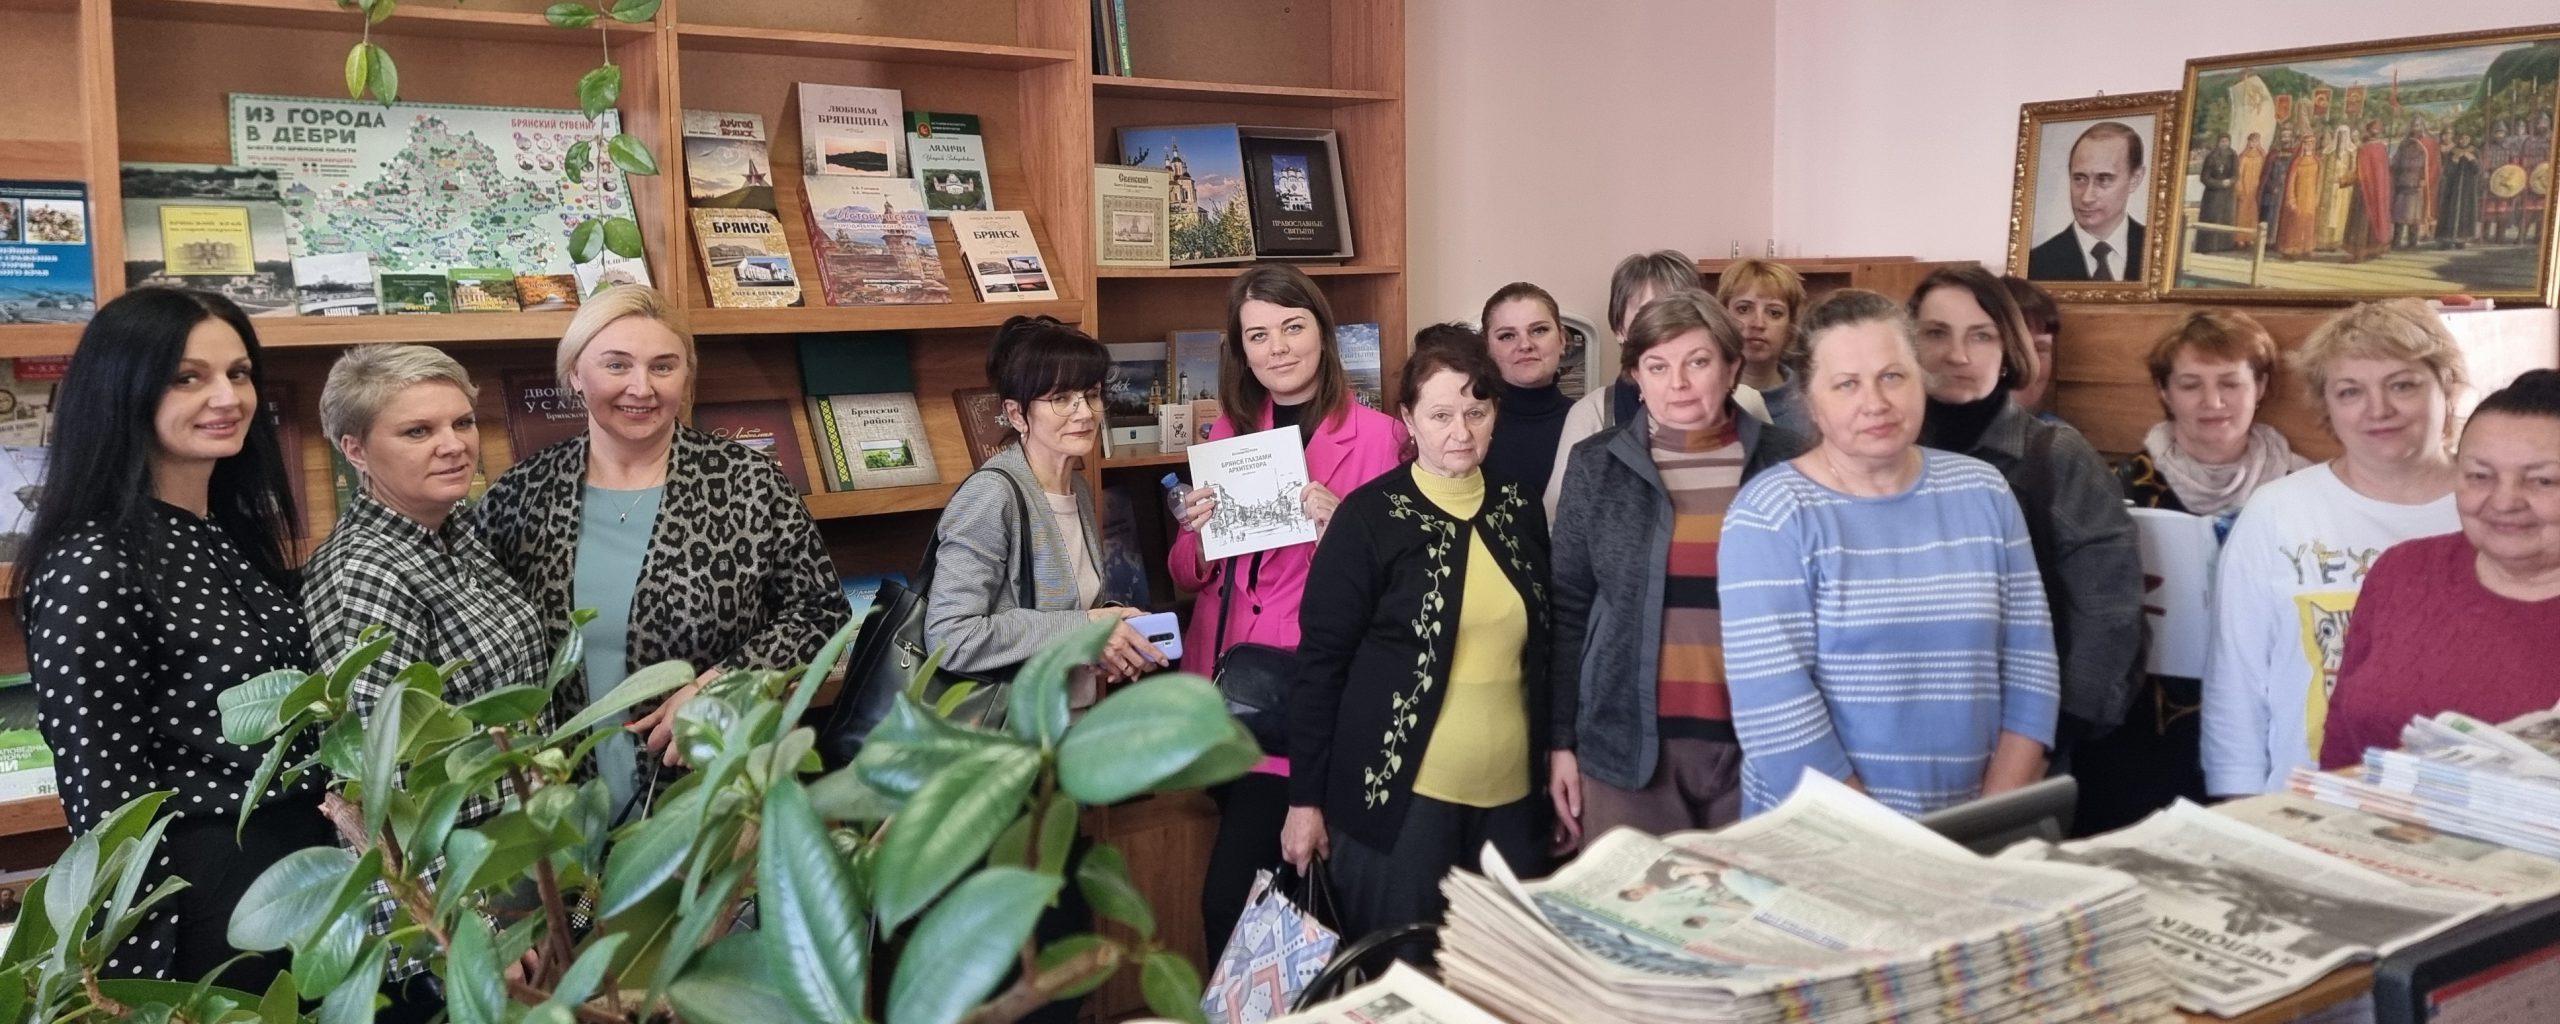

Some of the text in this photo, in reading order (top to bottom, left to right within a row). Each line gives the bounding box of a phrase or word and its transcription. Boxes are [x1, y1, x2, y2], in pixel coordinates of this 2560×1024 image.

[828, 105, 878, 115] ЛЮБИМАЯ
[245, 106, 386, 128] ИЗ ГОРОДА
[818, 114, 889, 127] БРЯНЩИНА
[511, 118, 597, 130] БРЯНСКИЙ СУВЕНИР
[246, 126, 356, 144] В ДЕБРИ
[712, 222, 770, 234] БРЯНСК
[973, 230, 1020, 239] БРЯНСК
[851, 407, 899, 417] Брянский
[864, 418, 894, 426] район
[1228, 461, 1267, 474] АРХИТЕКТОРА
